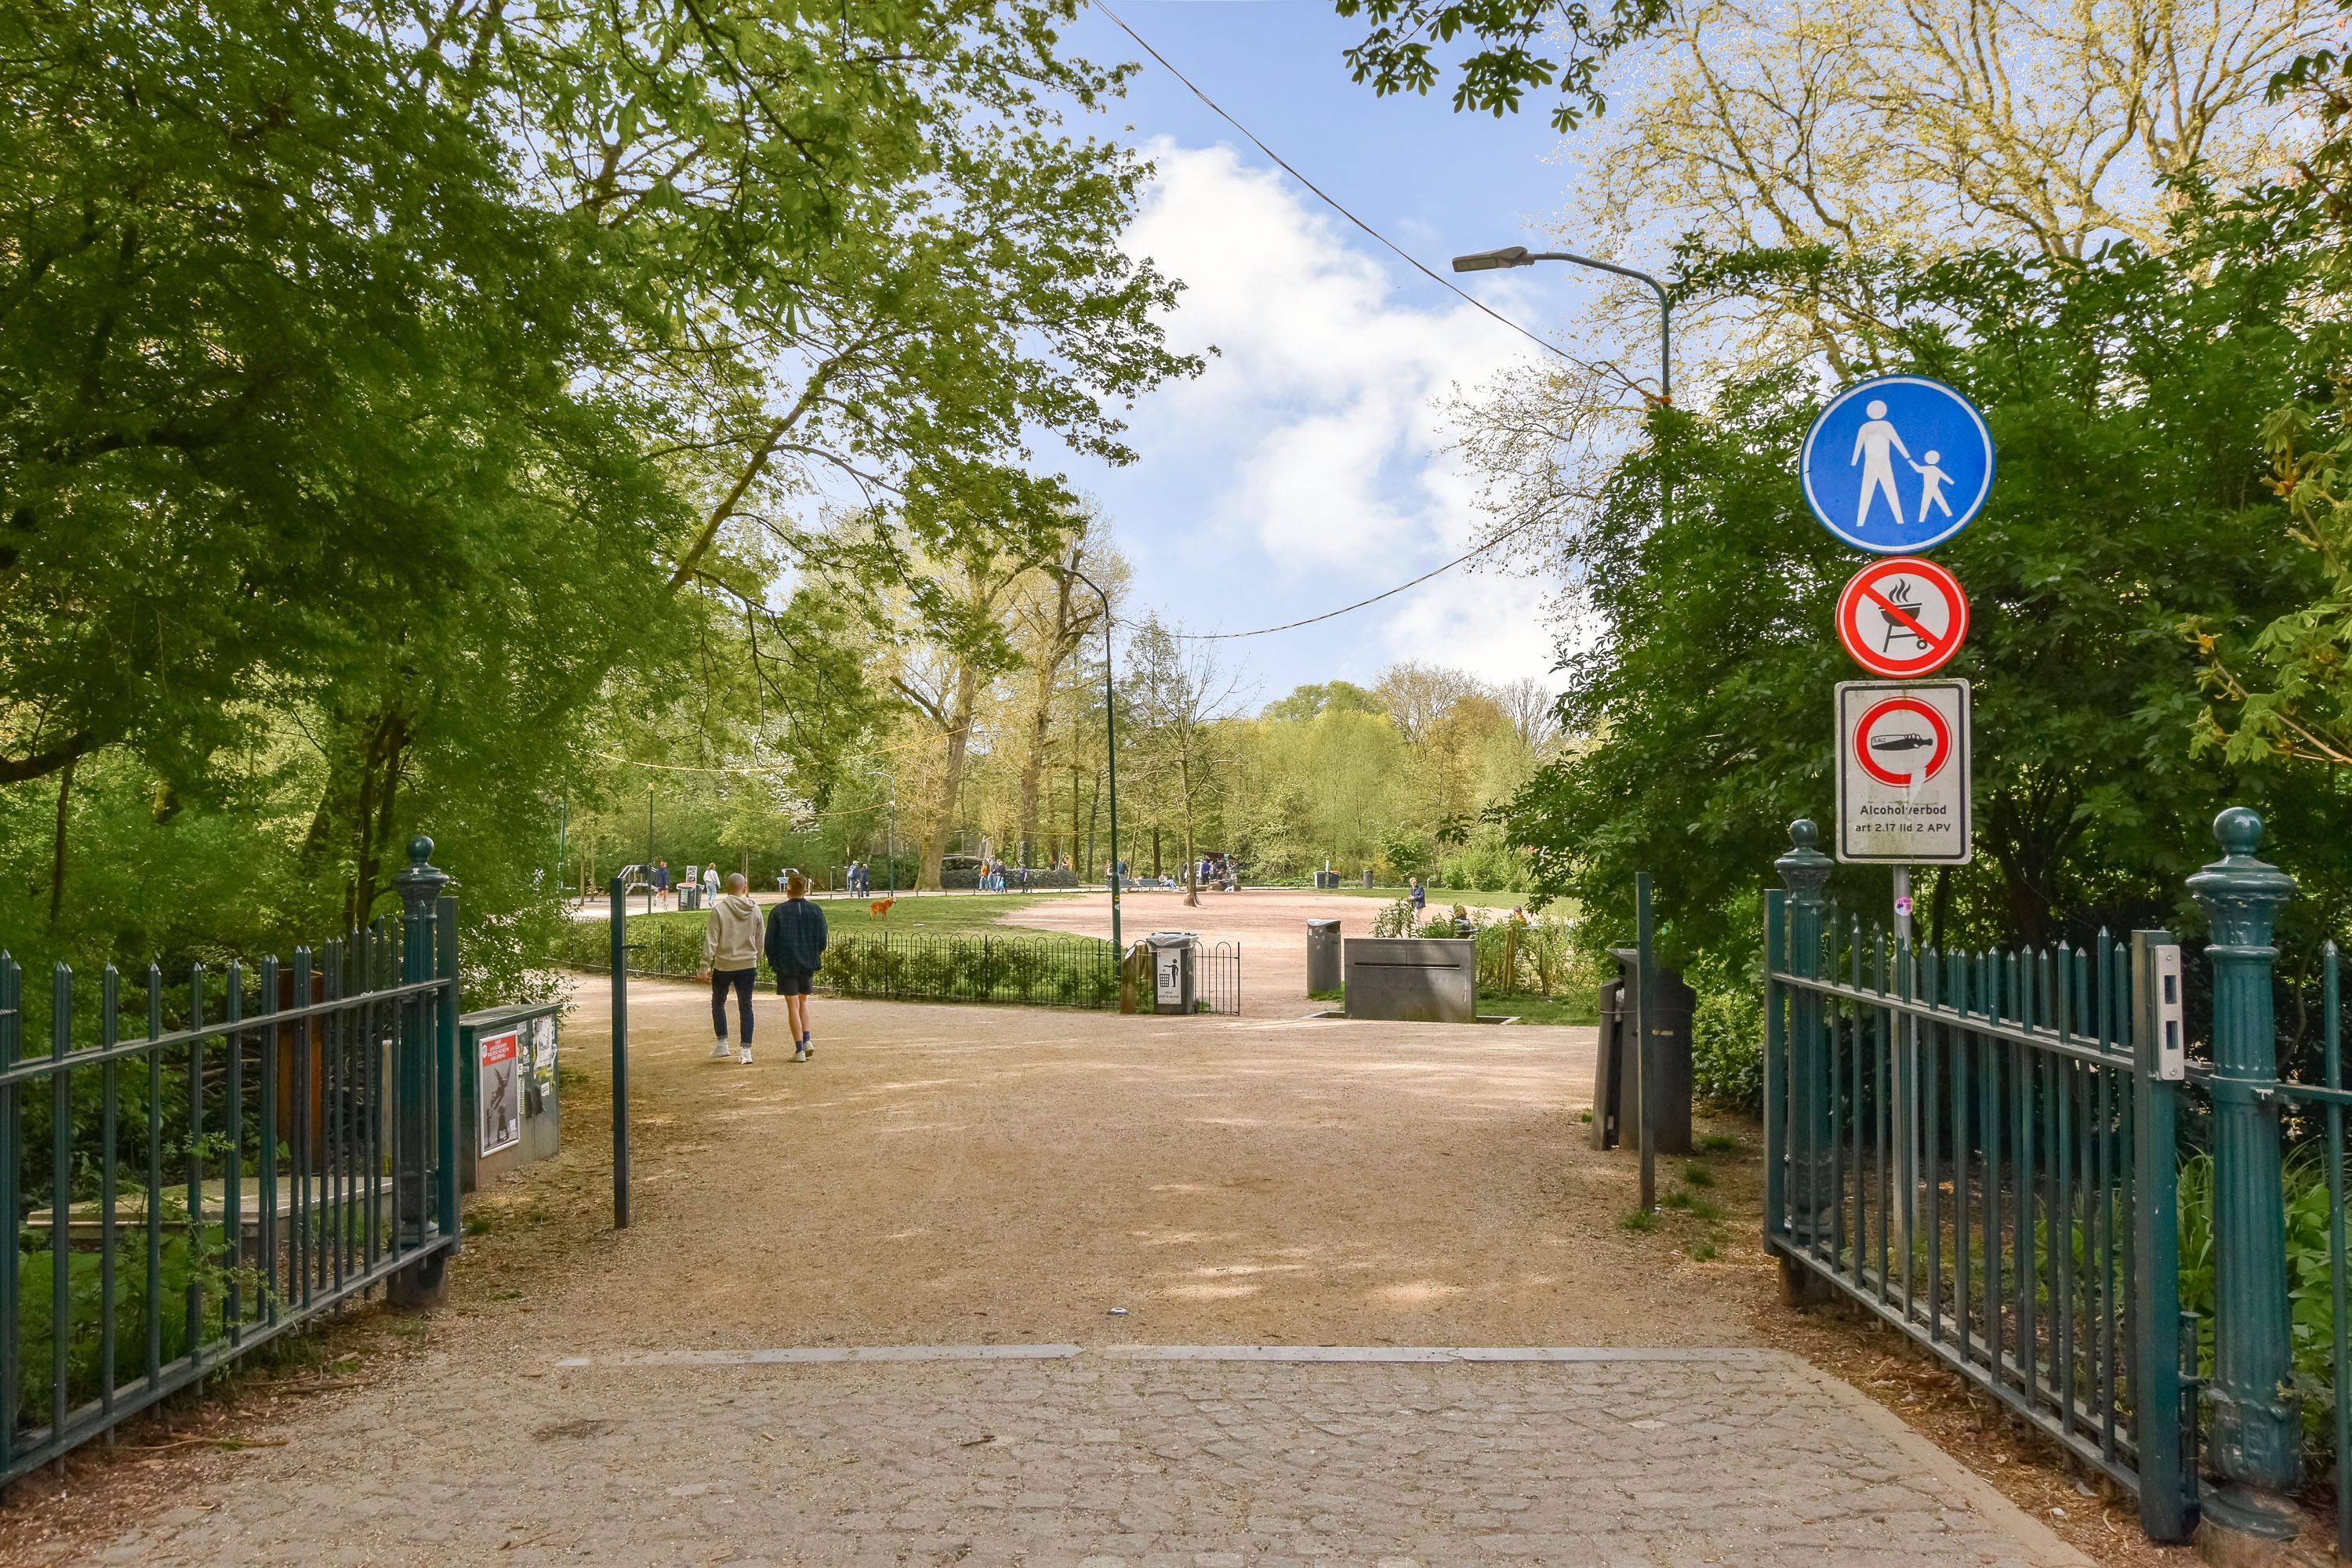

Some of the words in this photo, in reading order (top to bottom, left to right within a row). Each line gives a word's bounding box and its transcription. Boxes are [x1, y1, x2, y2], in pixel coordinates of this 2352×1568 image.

[1875, 823, 1896, 832] 2.17
[1900, 823, 1912, 832] lid
[1916, 823, 1924, 832] 2
[1927, 823, 1951, 832] APV
